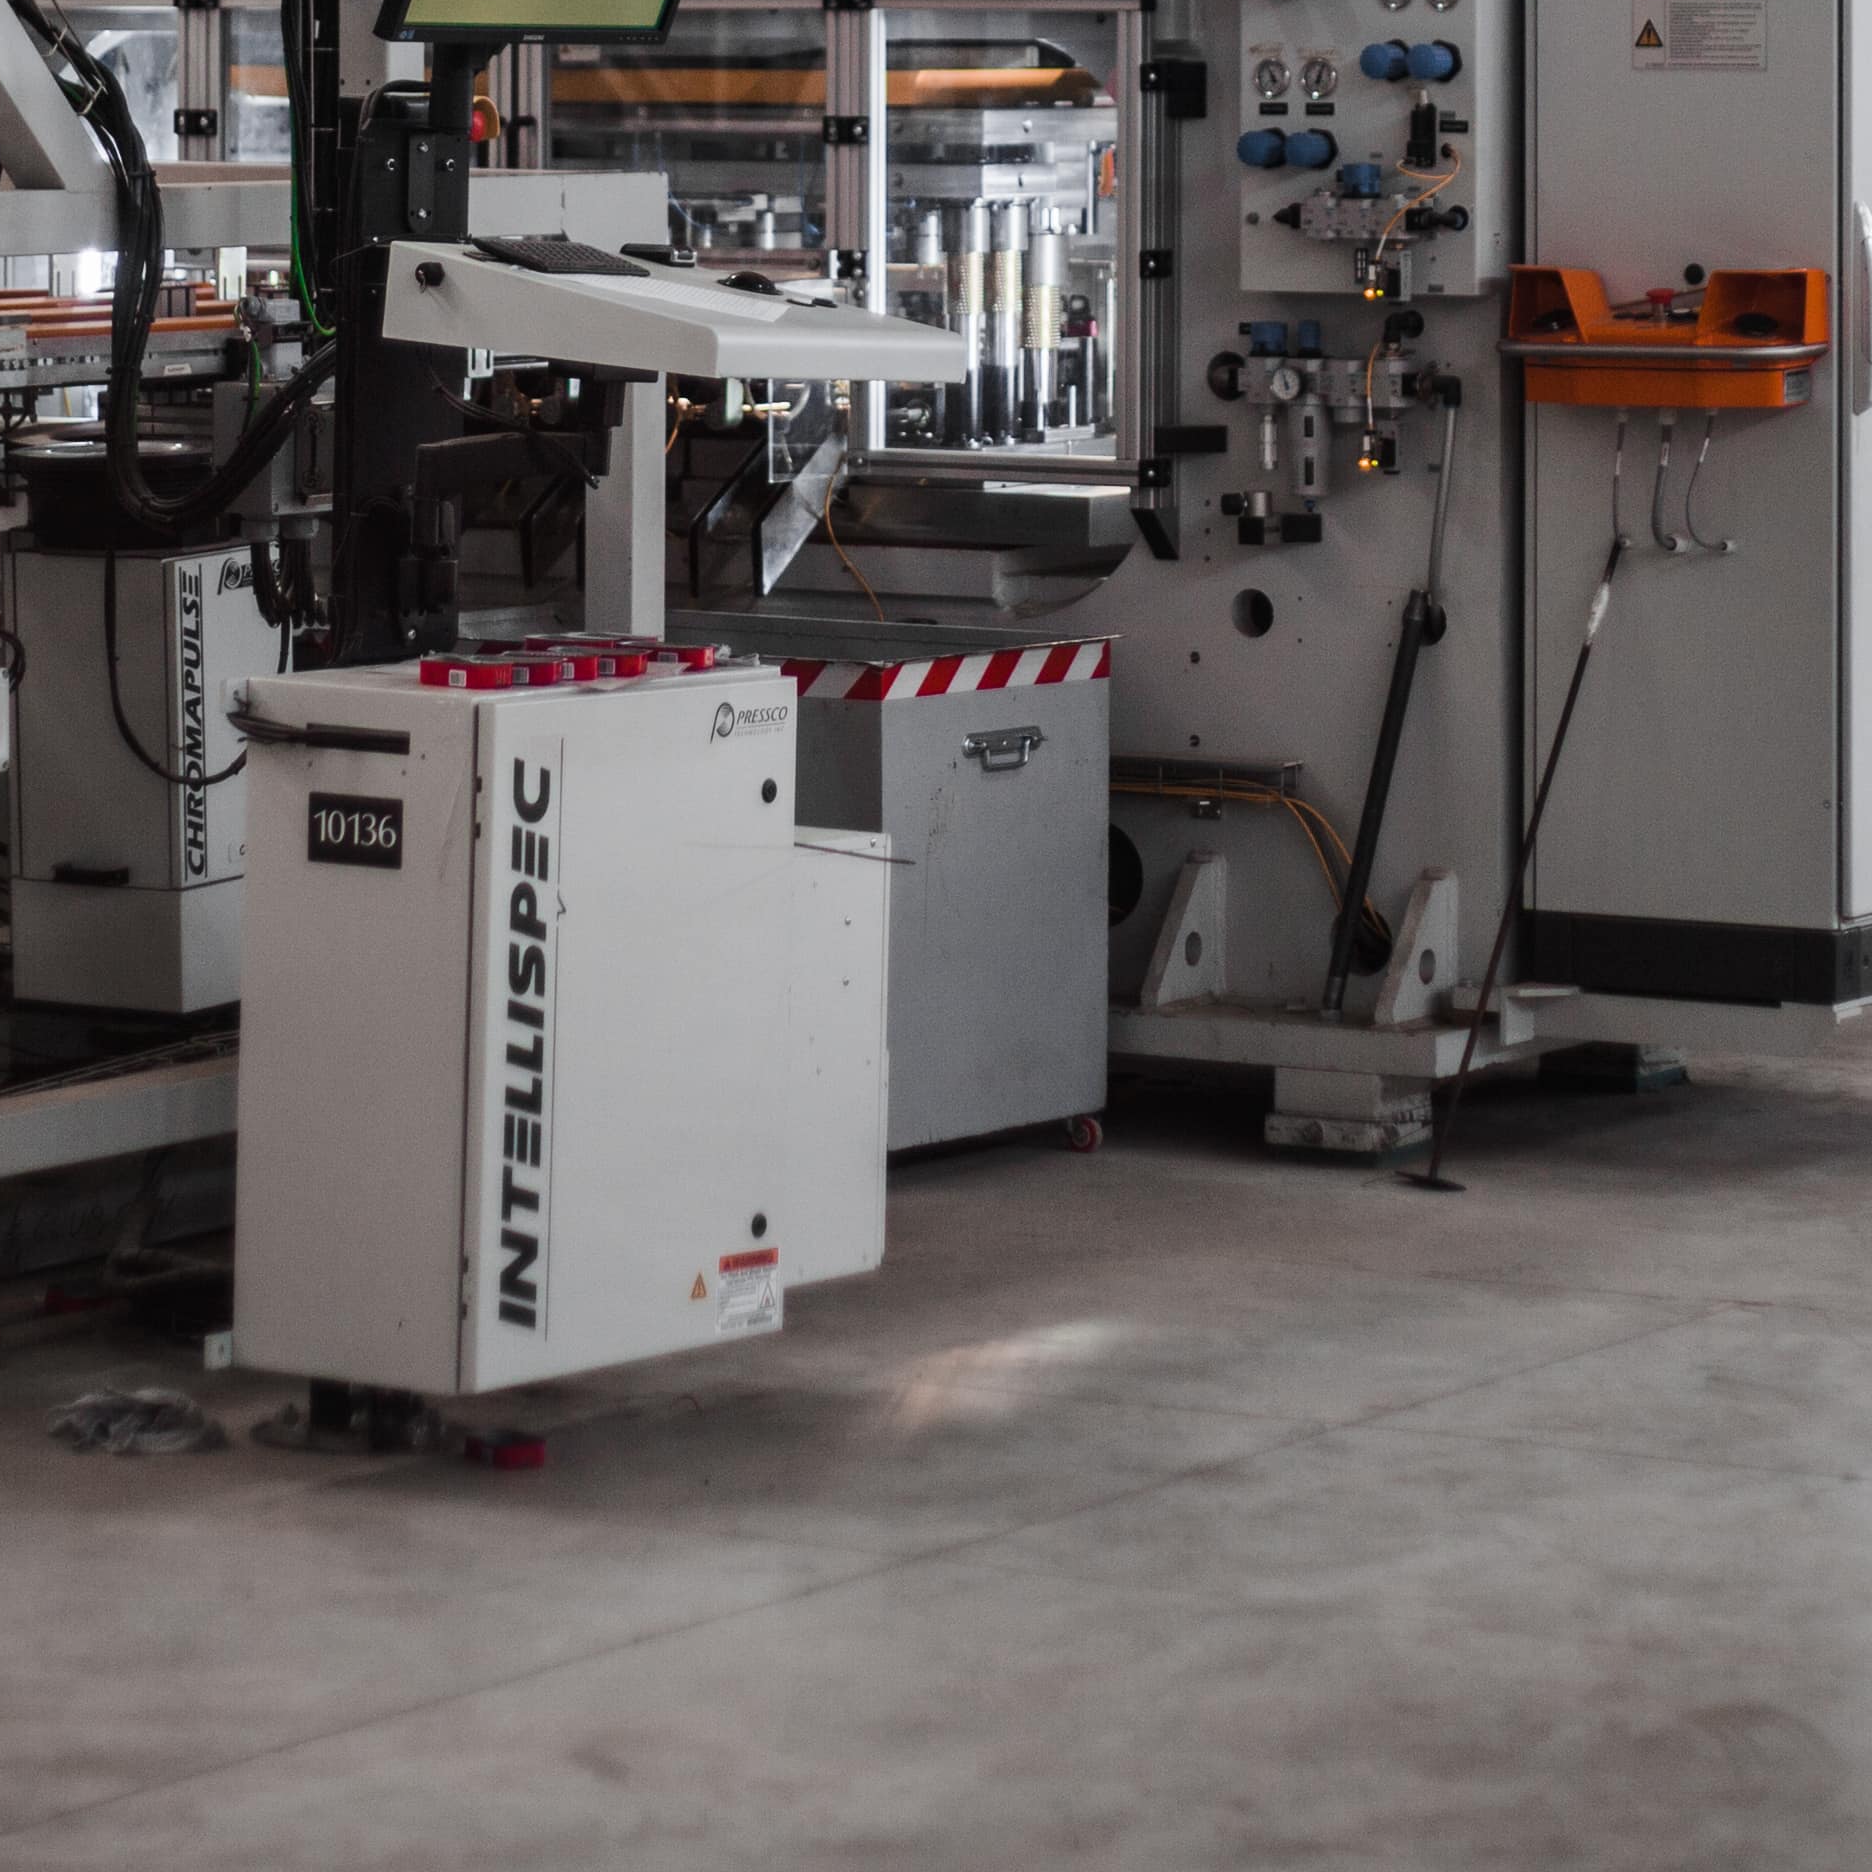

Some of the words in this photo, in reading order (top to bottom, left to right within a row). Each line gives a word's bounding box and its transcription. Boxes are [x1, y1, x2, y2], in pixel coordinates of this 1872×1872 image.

[183, 571, 204, 877] CHROMAPULSE
[736, 706, 788, 725] PRESSCO
[314, 809, 397, 848] 10136
[499, 757, 551, 1330] INTELLISPEC
